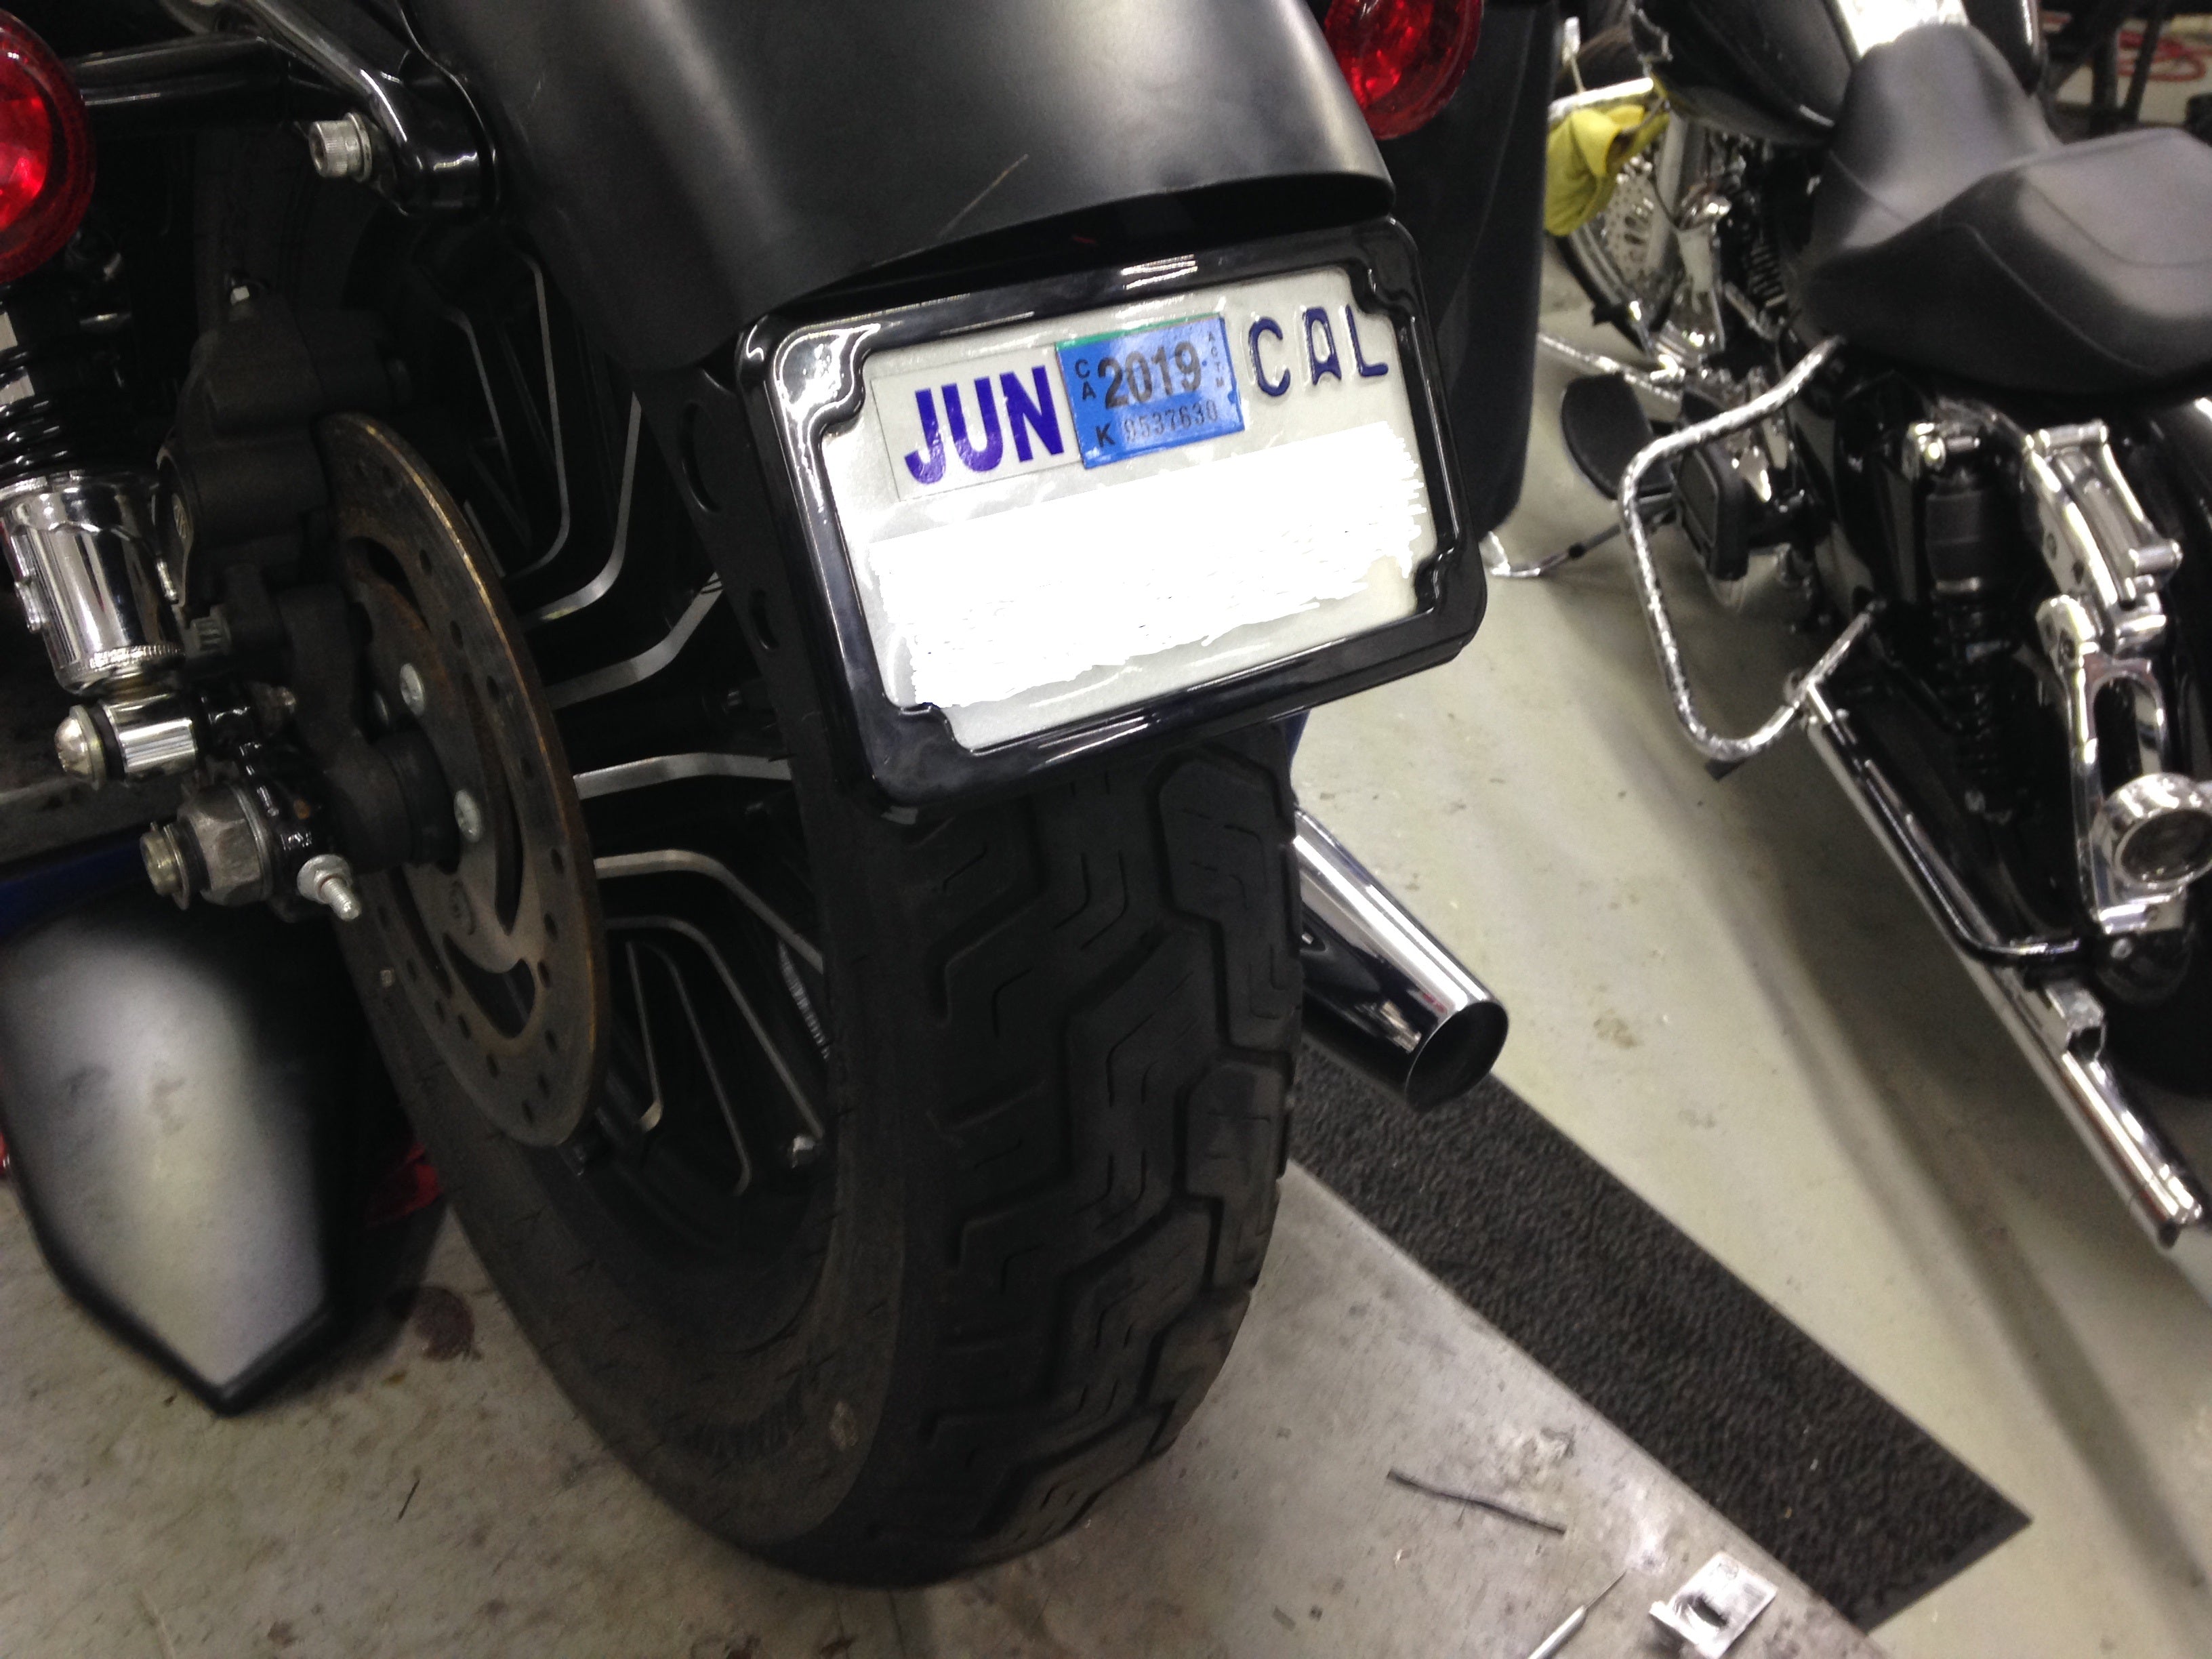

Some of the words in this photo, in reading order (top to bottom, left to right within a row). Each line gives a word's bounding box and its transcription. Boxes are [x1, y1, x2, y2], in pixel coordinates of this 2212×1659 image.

[1097, 340, 1202, 410] 2019
[1248, 305, 1389, 396] CAL
[904, 365, 1064, 484] JUN
[1095, 423, 1115, 448] K
